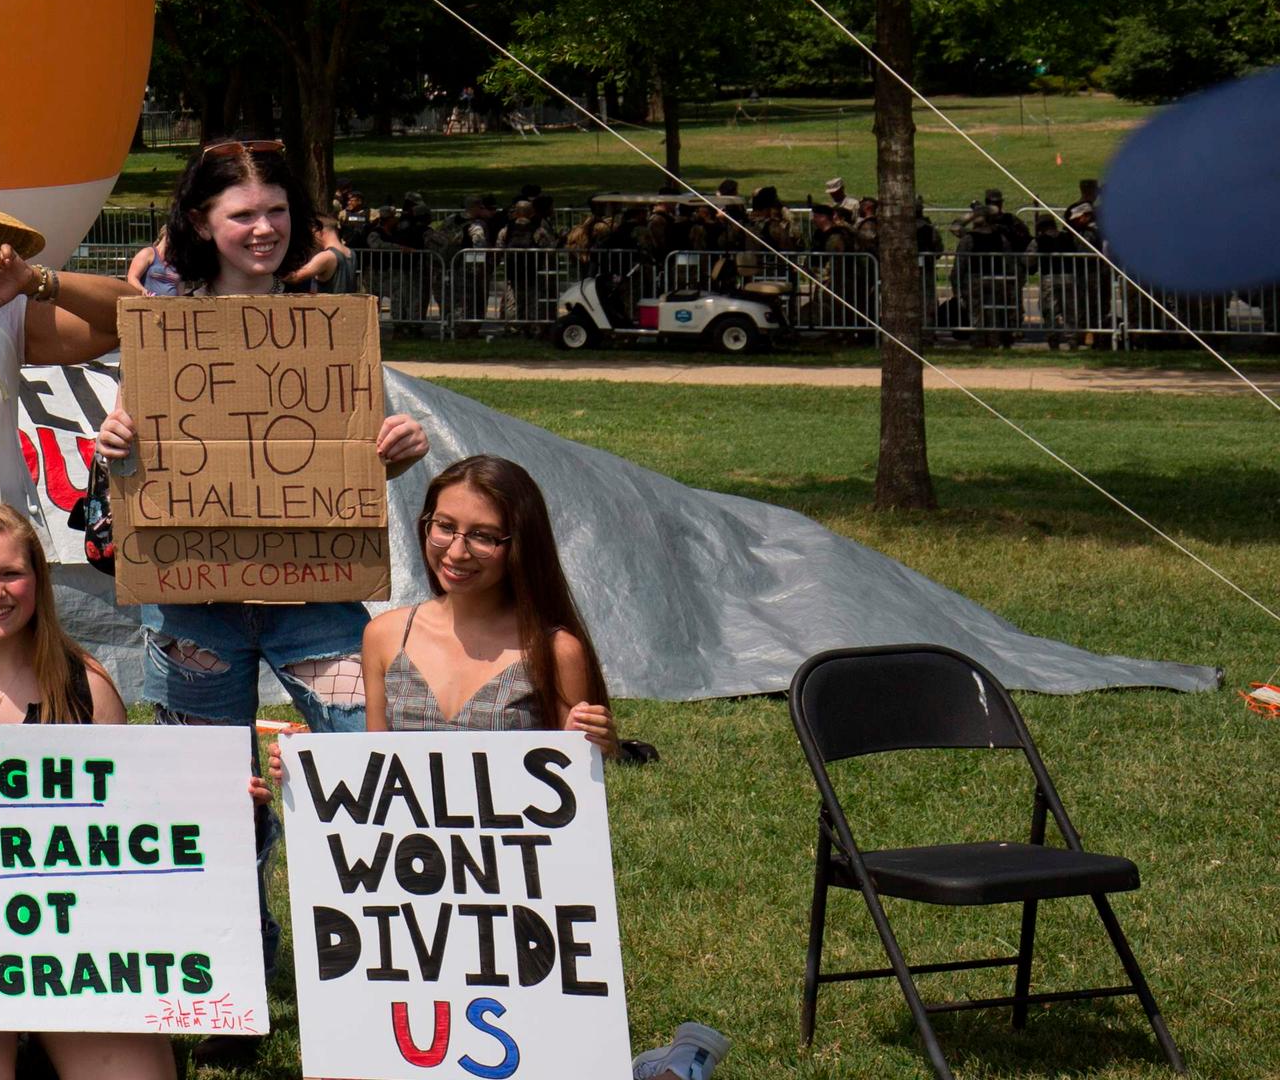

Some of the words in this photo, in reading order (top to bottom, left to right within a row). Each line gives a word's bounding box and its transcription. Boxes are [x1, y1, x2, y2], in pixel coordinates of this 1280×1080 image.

[126, 308, 220, 351] THE
[242, 306, 340, 351] DUTY
[175, 362, 236, 404] OF
[256, 361, 373, 413] YOUTH
[146, 414, 208, 476] IS
[229, 411, 316, 479] TO
[139, 480, 381, 520] CHALLENGE
[122, 530, 382, 565] CORRUPTION
[157, 563, 230, 593] KURT
[241, 561, 353, 587] COBAIN
[298, 747, 576, 829] WALLS
[327, 832, 552, 899] WONT
[312, 903, 609, 996] DIVIDE
[162, 1016, 202, 1028] THEM
[178, 1000, 221, 1017] LET
[391, 997, 520, 1080] US
